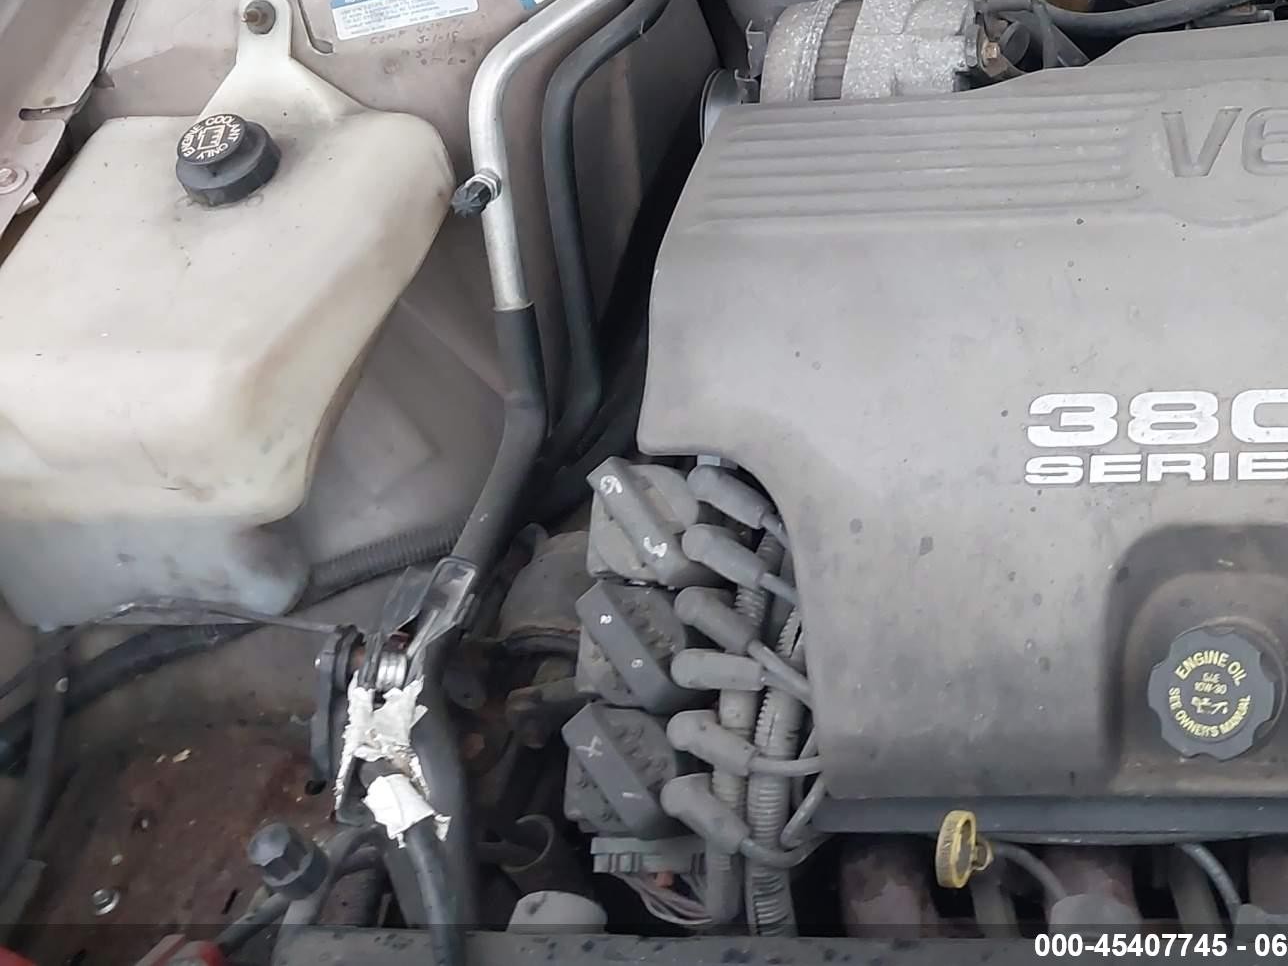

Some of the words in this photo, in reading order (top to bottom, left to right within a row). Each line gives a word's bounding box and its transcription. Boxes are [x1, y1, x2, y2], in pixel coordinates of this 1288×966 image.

[180, 125, 206, 157] ENGINE
[205, 115, 241, 142] COOLANT
[196, 142, 229, 160] ONLY
[1174, 650, 1229, 680] ENGINE
[1228, 661, 1247, 686] OIL
